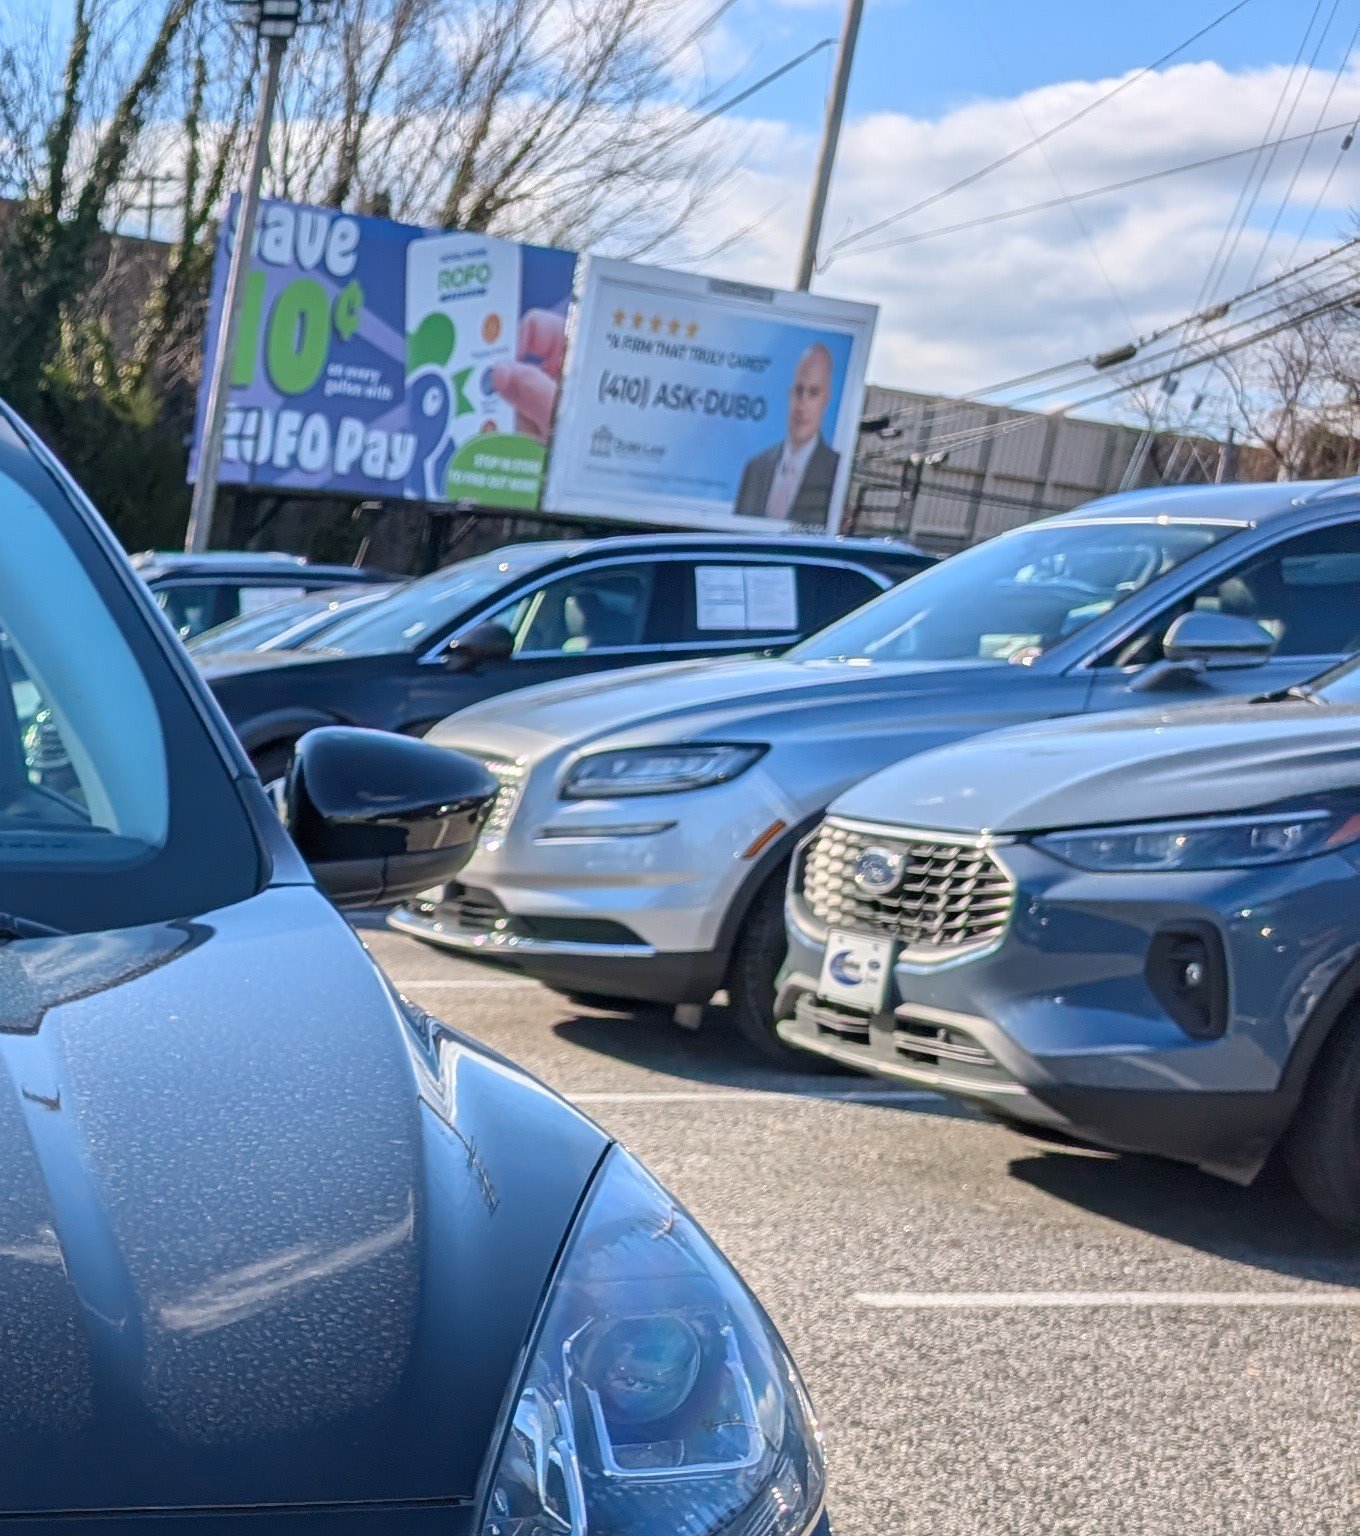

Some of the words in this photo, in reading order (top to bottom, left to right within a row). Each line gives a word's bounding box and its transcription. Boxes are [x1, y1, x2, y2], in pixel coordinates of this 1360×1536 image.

[438, 263, 492, 290] ROFO
[598, 369, 651, 411] (410)
[652, 382, 768, 422] ASK-DUBO
[334, 417, 418, 481] Pay
